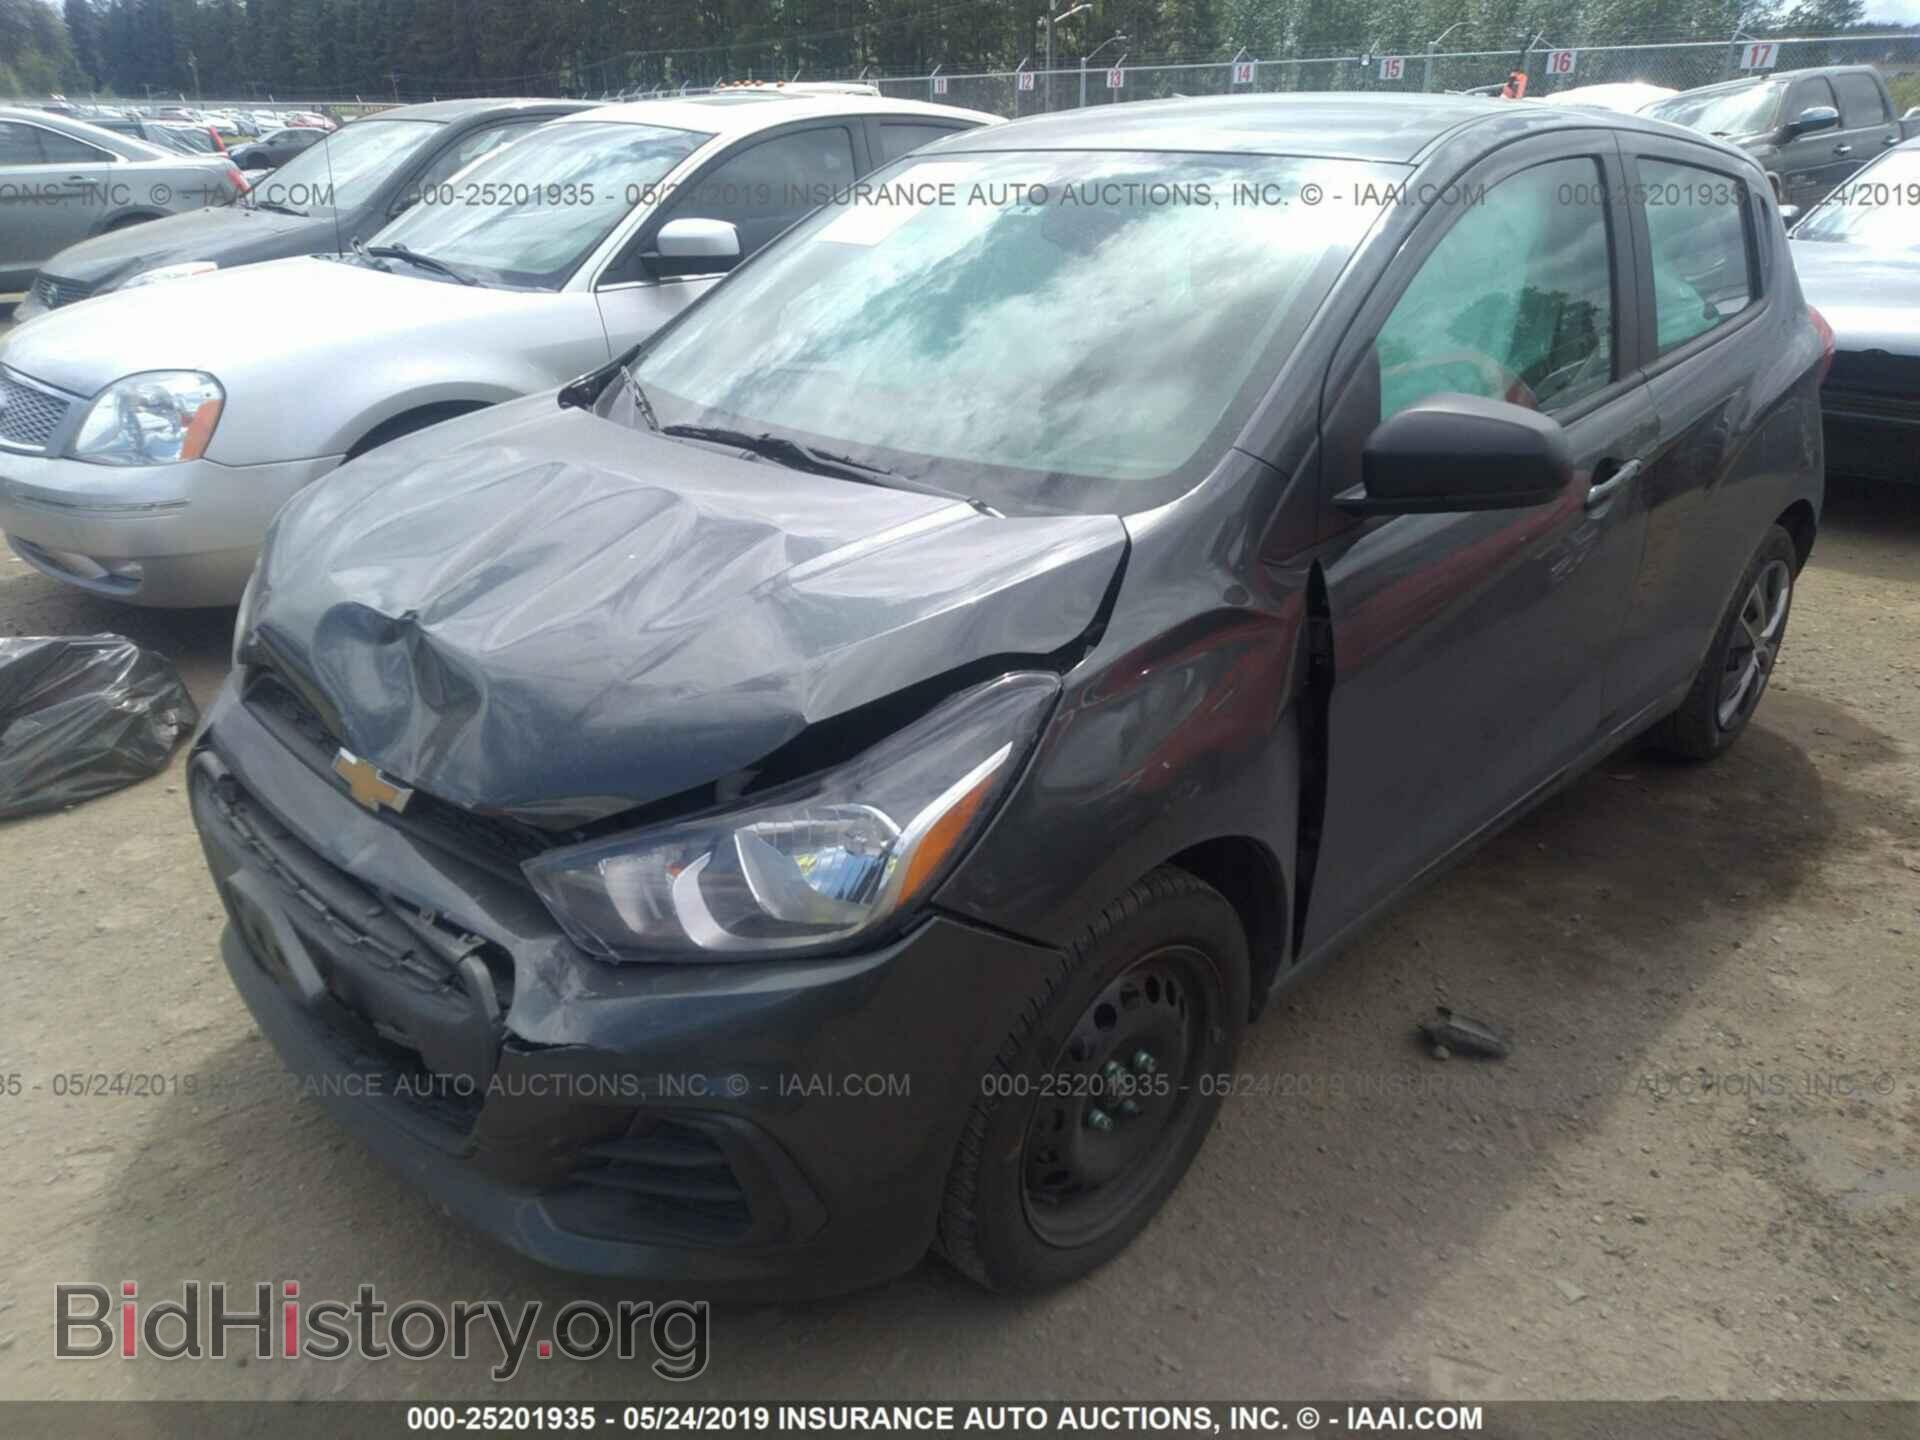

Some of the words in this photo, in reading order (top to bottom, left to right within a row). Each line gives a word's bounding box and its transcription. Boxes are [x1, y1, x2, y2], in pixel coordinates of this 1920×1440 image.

[1384, 55, 1399, 77] 15
[1553, 47, 1571, 73] 16
[1751, 45, 1771, 67] 17
[1237, 63, 1250, 81] 14
